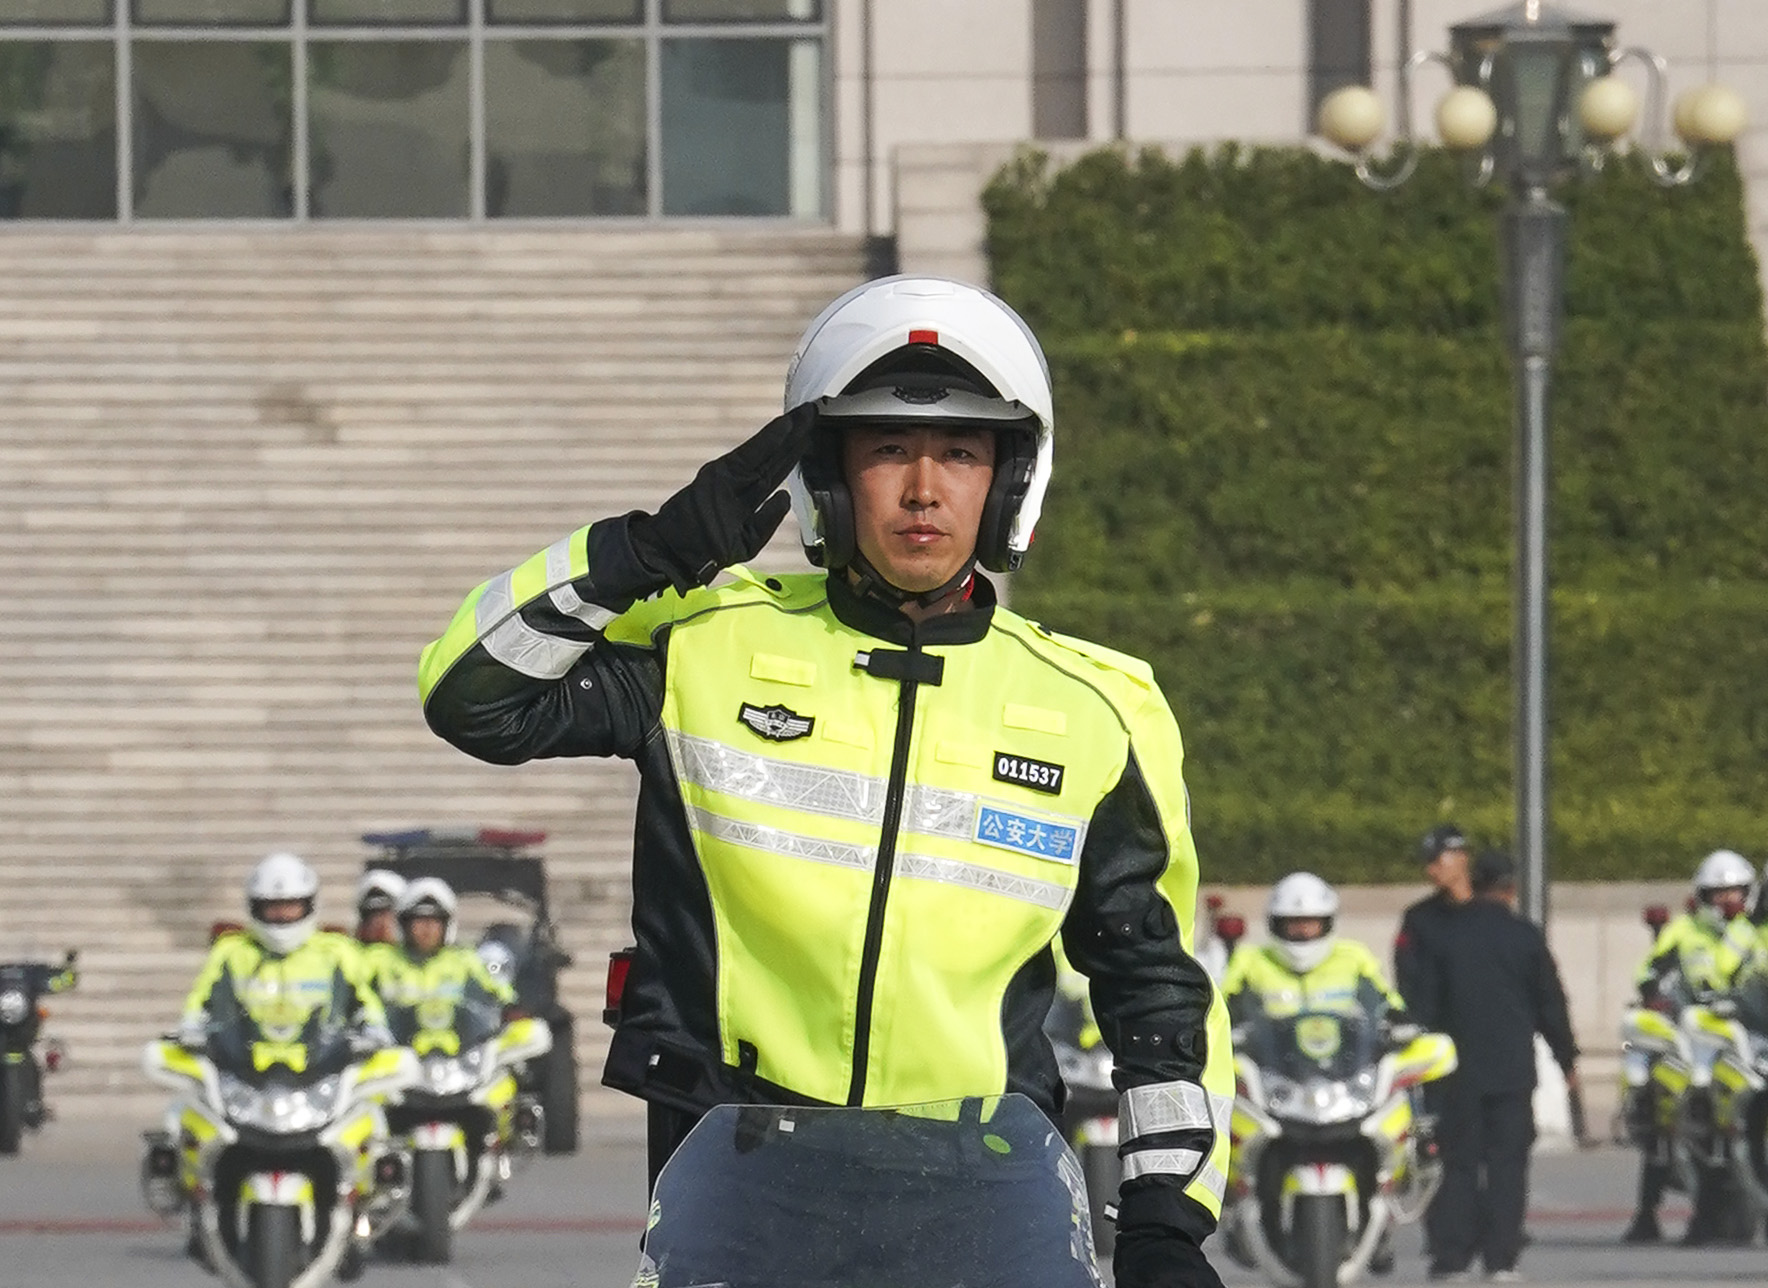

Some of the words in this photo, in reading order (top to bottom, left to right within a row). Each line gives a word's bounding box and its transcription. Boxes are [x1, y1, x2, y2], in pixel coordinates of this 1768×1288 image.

[998, 757, 1061, 787] 011537
[983, 813, 1073, 855] 公安大学
